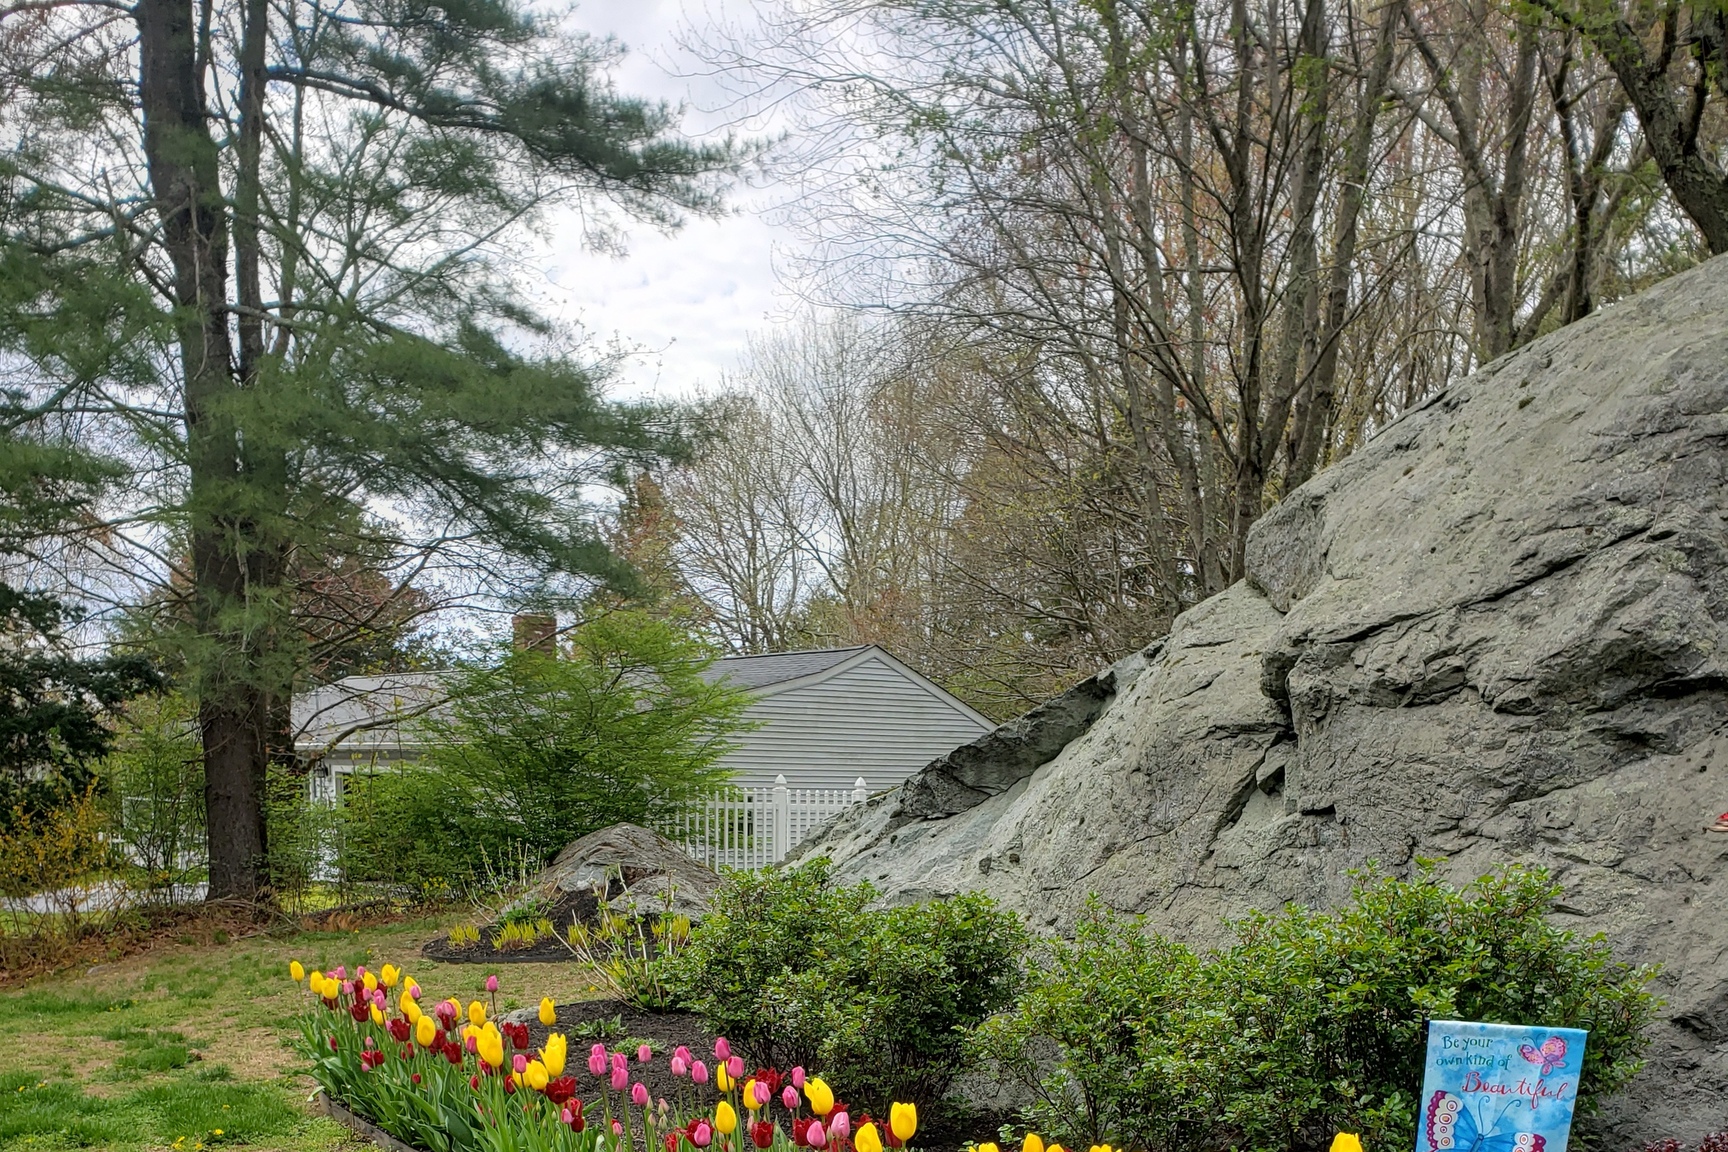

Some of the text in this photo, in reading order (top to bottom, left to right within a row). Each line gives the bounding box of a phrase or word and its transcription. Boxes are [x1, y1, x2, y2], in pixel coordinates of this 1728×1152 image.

[1441, 1035, 1493, 1051] Be your
[1436, 1052, 1512, 1071] own kind of
[1461, 1071, 1569, 1110] Beautiful
